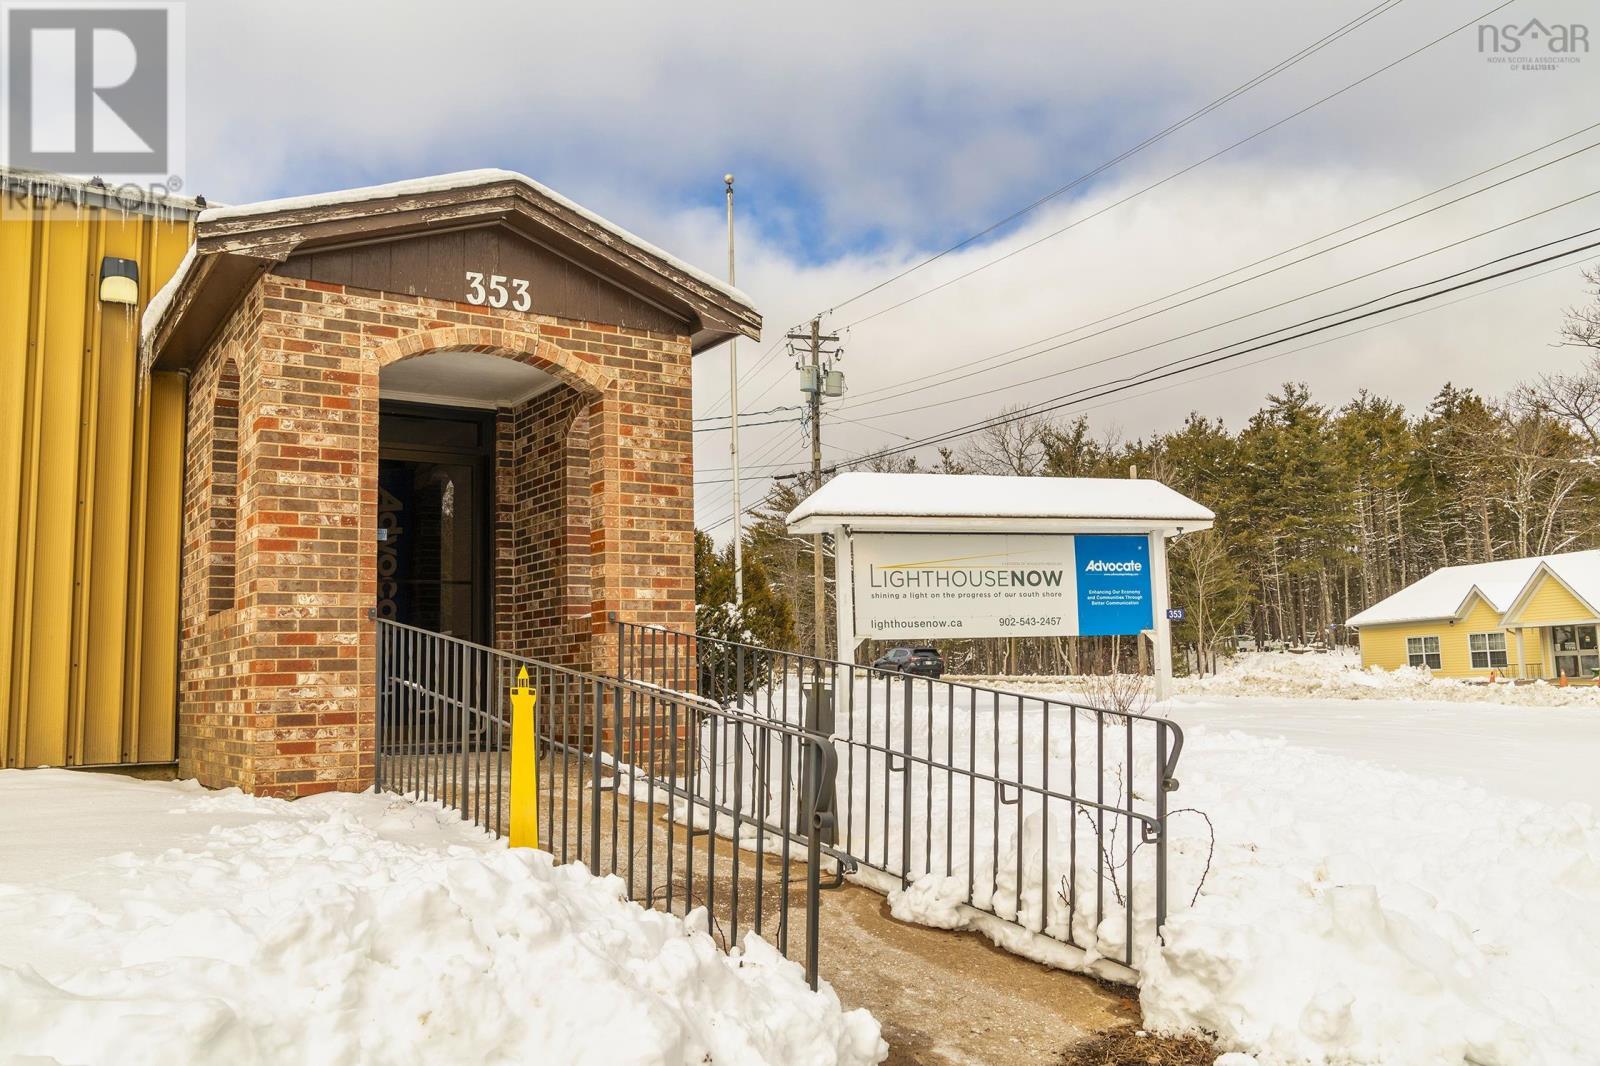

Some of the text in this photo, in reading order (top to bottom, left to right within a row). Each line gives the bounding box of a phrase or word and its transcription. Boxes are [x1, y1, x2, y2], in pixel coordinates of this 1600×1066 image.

[465, 271, 532, 312] 353
[1085, 560, 1142, 572] Advocate
[871, 592, 900, 600] shining
[909, 592, 928, 600] light
[942, 591, 956, 599] the
[957, 592, 991, 600] progress
[1168, 610, 1182, 619] 353
[871, 619, 963, 630] lighthousenow.ca
[999, 617, 1061, 626] 902-543-2457
